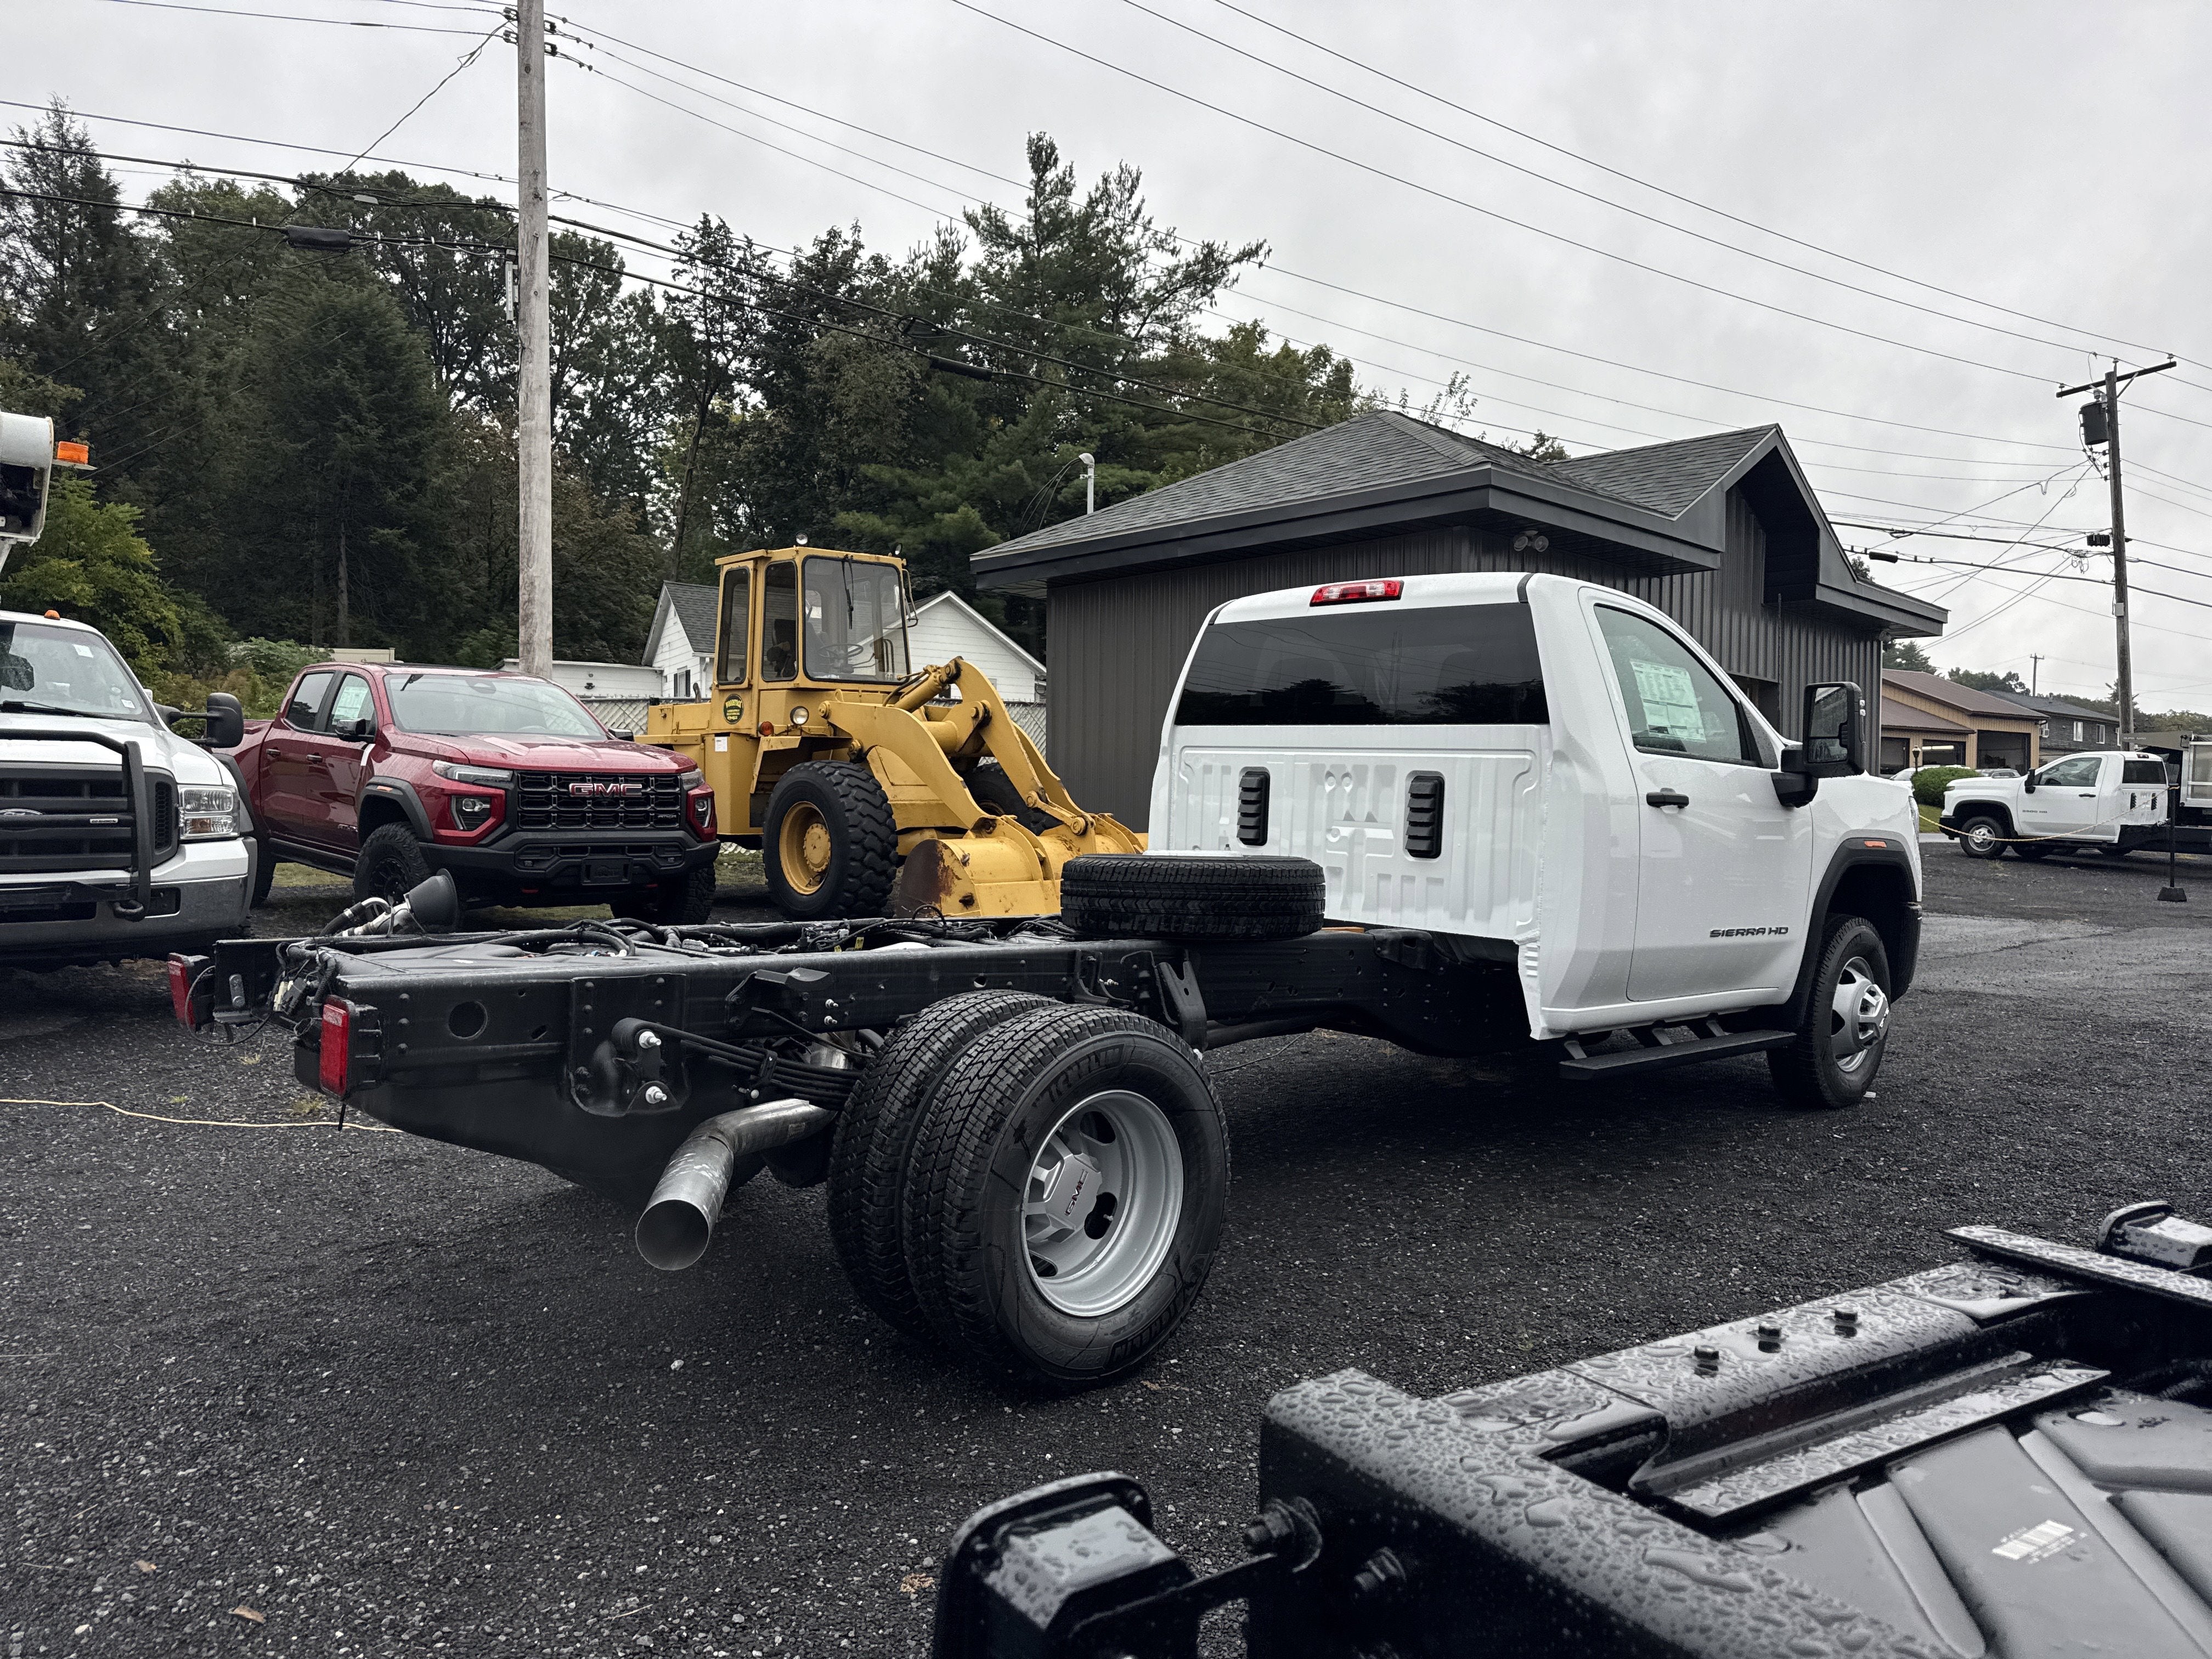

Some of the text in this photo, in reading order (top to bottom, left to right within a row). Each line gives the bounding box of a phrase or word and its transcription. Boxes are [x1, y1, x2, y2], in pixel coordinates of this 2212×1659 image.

[569, 783, 642, 797] GMC
[1709, 927, 1788, 938] SIERRA HD
[1064, 1168, 1089, 1217] GMC
